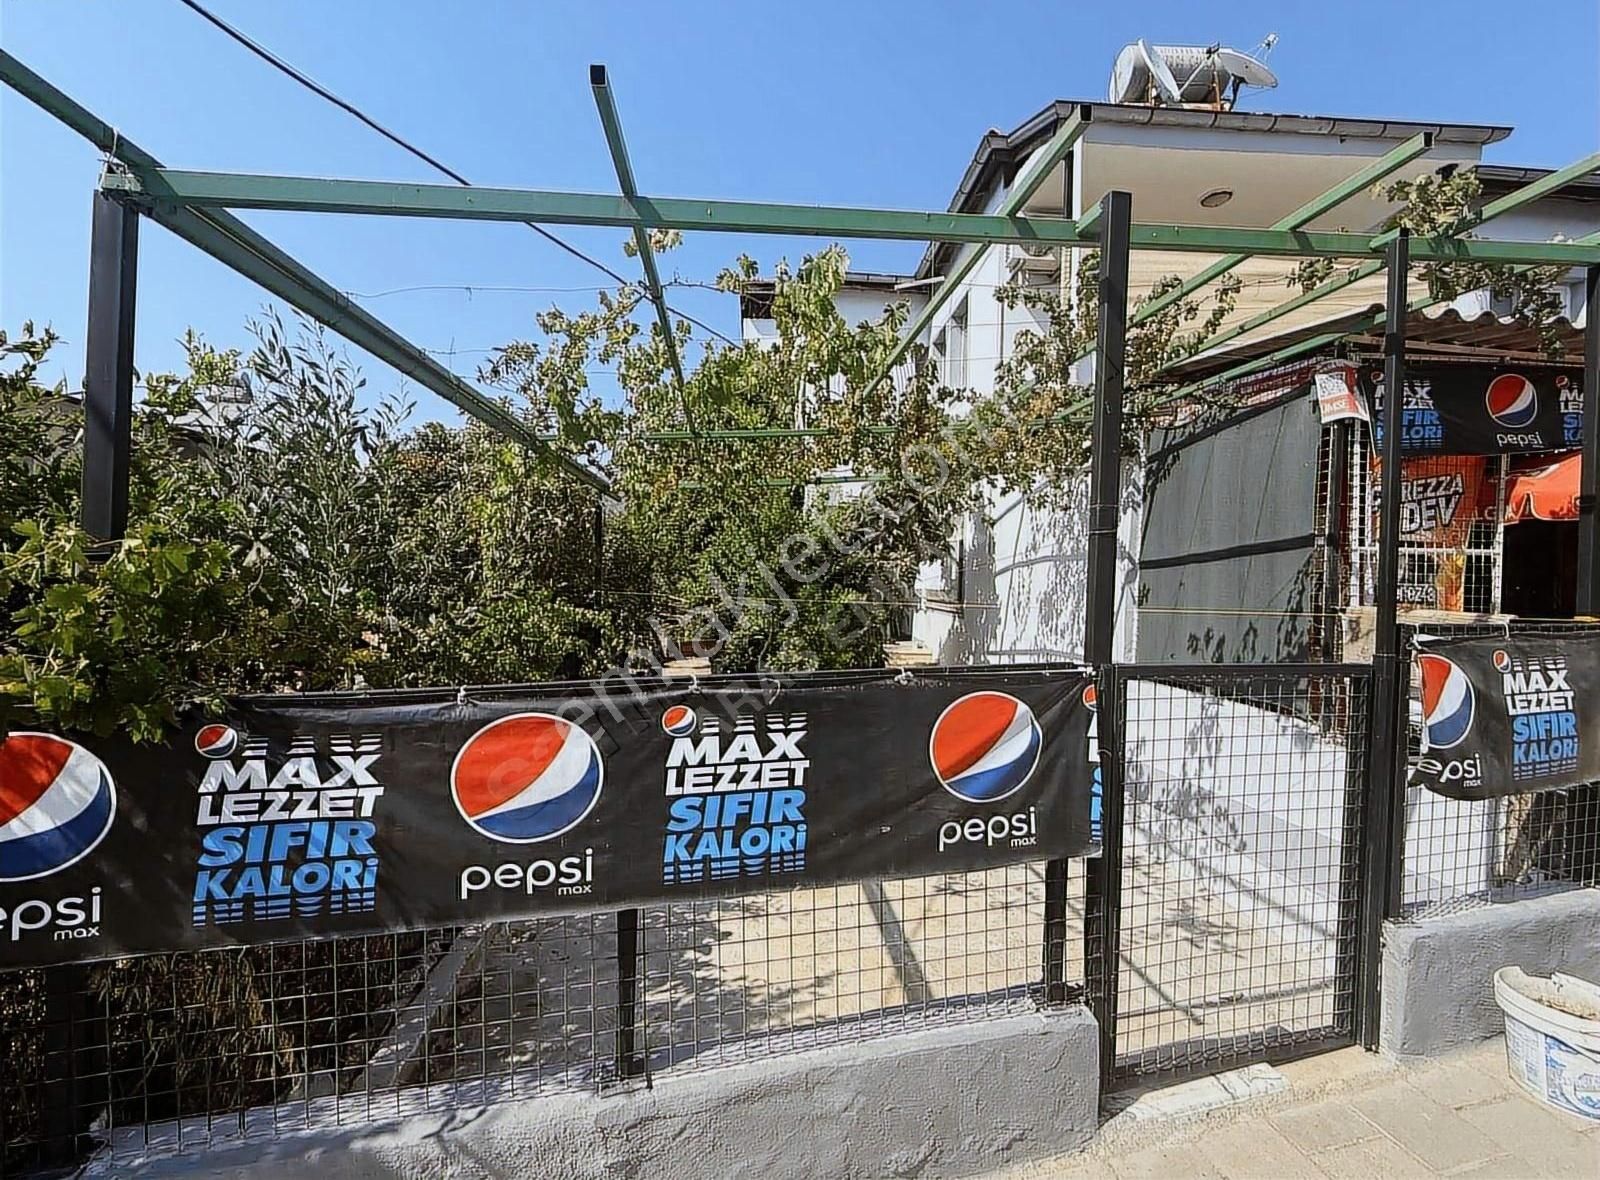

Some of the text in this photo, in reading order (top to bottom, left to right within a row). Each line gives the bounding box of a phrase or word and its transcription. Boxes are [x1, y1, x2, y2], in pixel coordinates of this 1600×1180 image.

[1497, 431, 1543, 448] pepsi
[1502, 668, 1572, 695] MAX
[1506, 691, 1575, 716] LEZZET
[1512, 711, 1577, 743] SIFIR
[666, 729, 807, 768] MAX
[197, 752, 383, 794] MAX
[664, 759, 809, 797] LEZZET
[1463, 779, 1482, 788] max
[195, 785, 385, 826] LEZZET
[666, 789, 806, 833] SIFIR
[197, 820, 378, 868] SIFIR
[938, 805, 1038, 852] pepsi
[1009, 836, 1038, 848] max
[458, 847, 594, 900] pepsi
[556, 882, 593, 896] max
[53, 925, 101, 942] max
